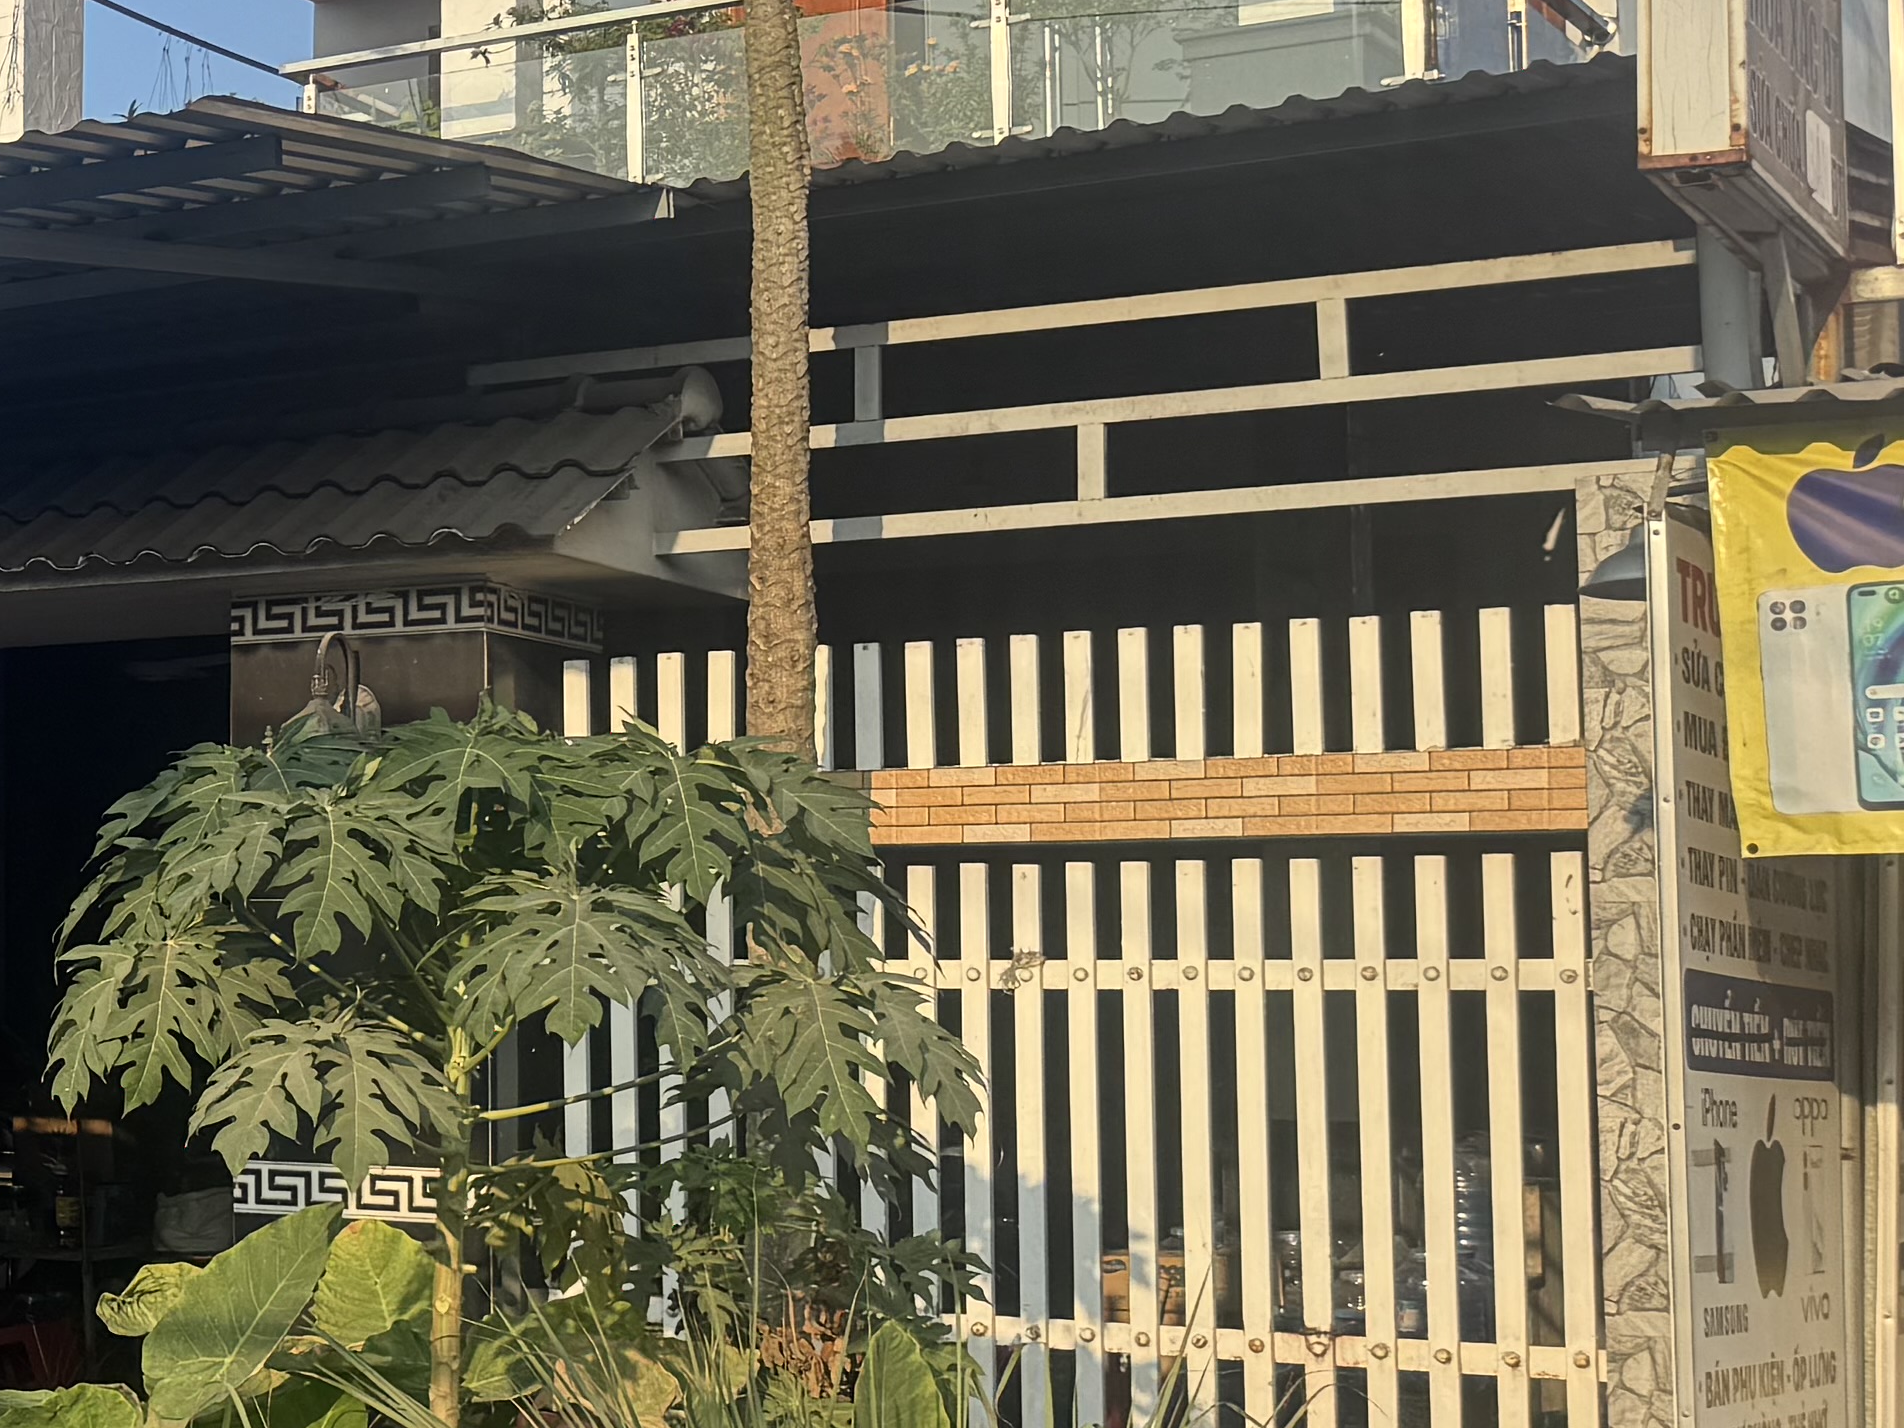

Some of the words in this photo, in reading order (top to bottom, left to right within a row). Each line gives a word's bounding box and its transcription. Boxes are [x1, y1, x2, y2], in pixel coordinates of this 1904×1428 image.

[1681, 638, 1712, 694] SỬA
[1683, 710, 1718, 758] MUA
[1685, 779, 1714, 824] THAY
[1687, 846, 1716, 889] THAY
[1718, 854, 1739, 895] PIN
[1689, 912, 1717, 962] CHẠY
[1691, 988, 1742, 1060] CHUYỂN
[1700, 1087, 1738, 1129] iPhone
[1703, 1303, 1749, 1339] SAMSUNG
[1800, 1284, 1831, 1323] vivo
[1704, 1359, 1730, 1409] BÁN
[1731, 1363, 1757, 1411] PHỤ
[1758, 1351, 1785, 1407] KIỆN
